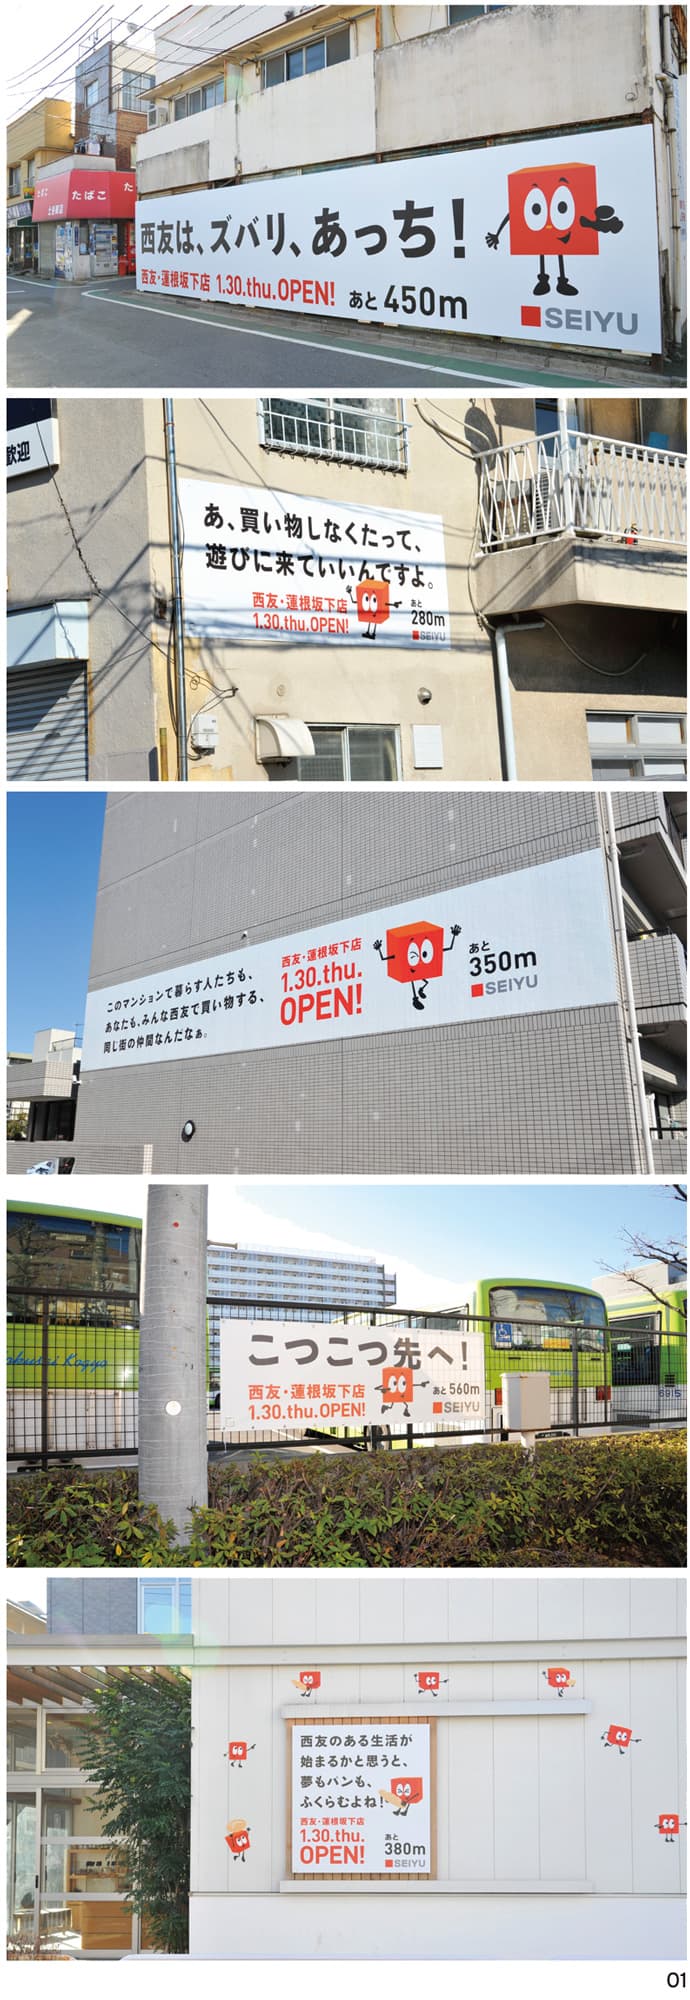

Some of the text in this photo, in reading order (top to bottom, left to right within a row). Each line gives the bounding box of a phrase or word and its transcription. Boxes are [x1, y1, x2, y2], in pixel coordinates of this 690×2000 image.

[71, 190, 107, 201] たばこ
[140, 198, 466, 259] 西友は、ズバリ、あっち!
[141, 268, 335, 307] 西友・蓮根坂下店 1.30.thu.OPEN!
[349, 284, 468, 320] あと 450m
[544, 307, 639, 336] SEIYU
[203, 502, 422, 553] あ、買い物しなくたって、
[205, 542, 434, 591] 遊びに来ていいんですよ。
[252, 591, 348, 614] 西友・蓮根坂下店
[410, 599, 422, 608] あと
[252, 612, 349, 634] 1.30.thu.OPEN!
[411, 610, 445, 627] 280m
[420, 630, 446, 641] SEIYU
[281, 937, 362, 968] 西友・蓮根坂下店
[469, 940, 491, 954] あと
[469, 950, 538, 977] 350m
[280, 961, 363, 993] 1.30.thu.
[485, 974, 539, 996] SEIYU
[106, 967, 253, 1014] このマンションで暮らす人たちも、
[104, 990, 266, 1034] あなたも、みんな西友で買い物する、
[280, 983, 362, 1026] OPEN!
[103, 1027, 208, 1054] 同じ街の仲間なんだなぁ。
[248, 1334, 469, 1371] こつこつ先へ!
[248, 1384, 366, 1401] 西友・蓮根坂下店
[432, 1382, 481, 1396] あと 560m
[248, 1402, 367, 1421] 1.30.thu.OPEN!
[443, 1401, 481, 1414] SEIYU
[300, 1734, 413, 1748] 西友のある生活が
[300, 1754, 408, 1768] 始まるかと思うと、
[300, 1795, 385, 1809] ふくらむよね!
[300, 1817, 365, 1826] 西友・蓮根坂下店
[299, 1828, 365, 1843] 1.30.thu.
[384, 1833, 399, 1841] あと
[300, 1845, 365, 1864] OPEN!
[384, 1842, 426, 1856] 380m
[394, 1859, 426, 1868] SEIYU
